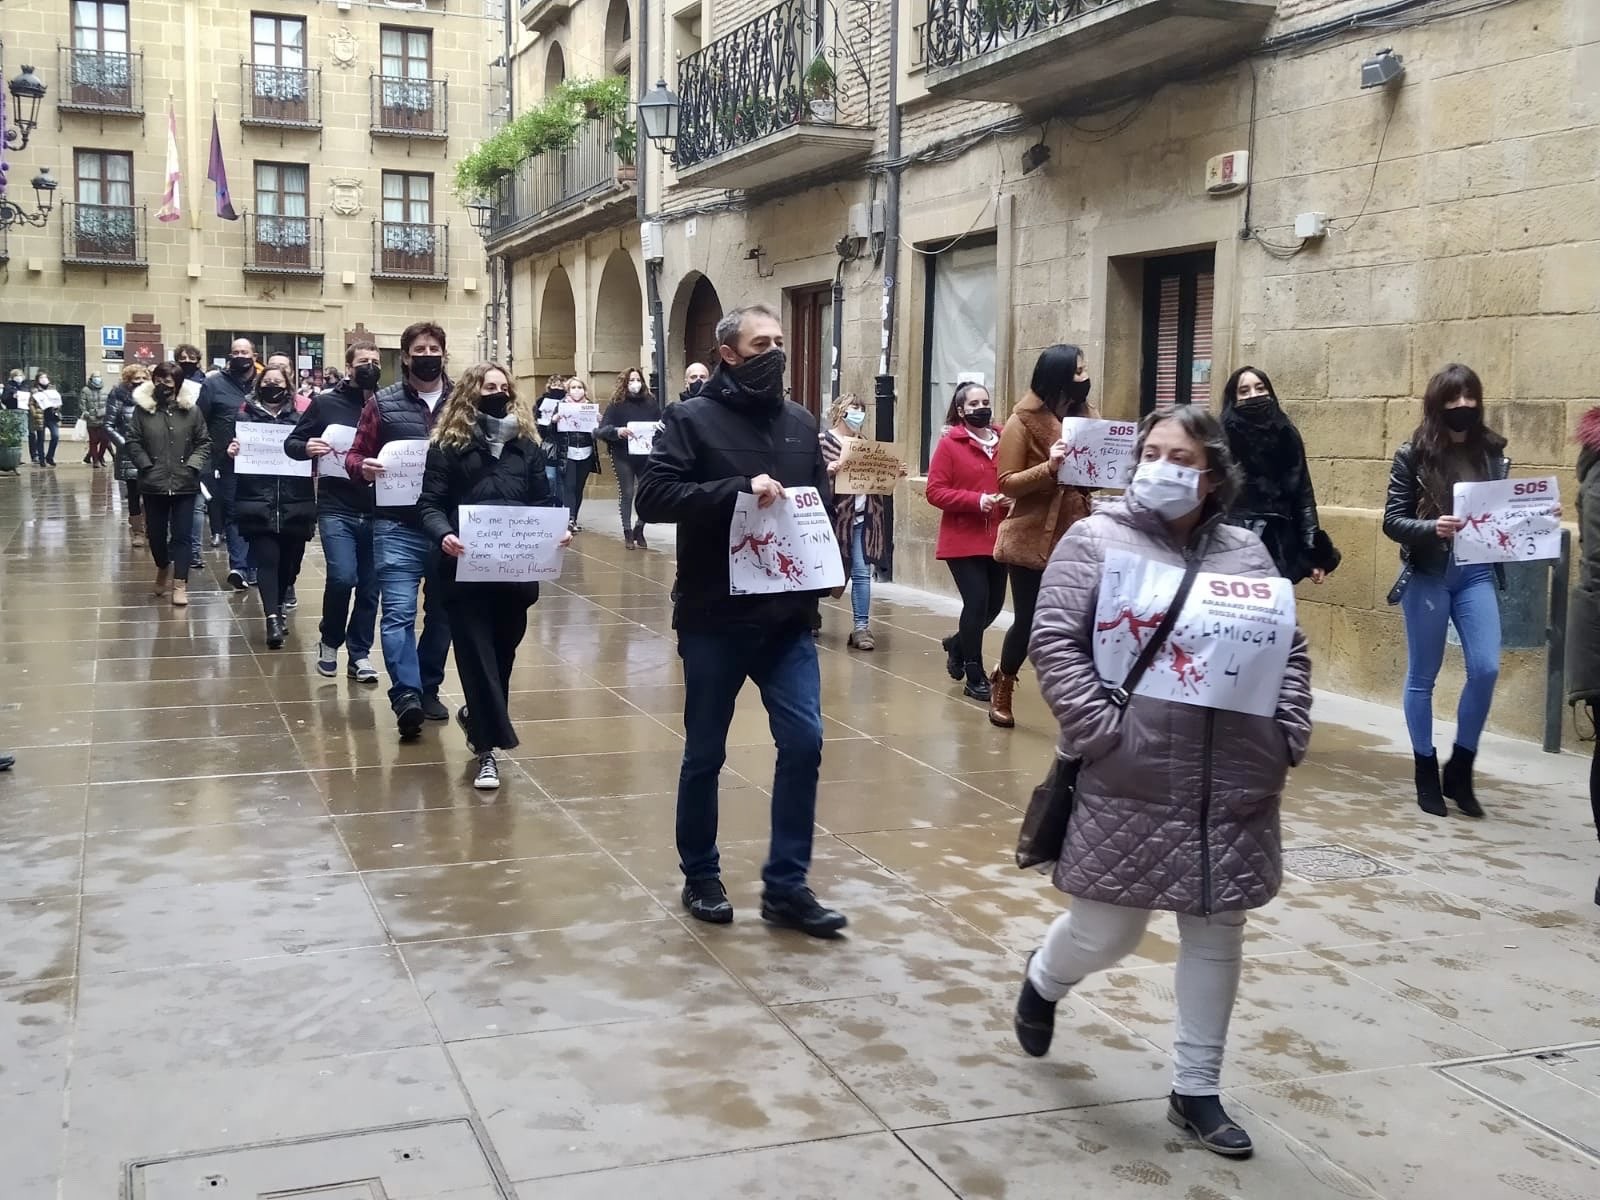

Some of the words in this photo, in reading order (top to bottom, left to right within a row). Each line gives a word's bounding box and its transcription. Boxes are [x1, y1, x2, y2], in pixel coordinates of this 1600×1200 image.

[107, 329, 118, 339] H
[1109, 426, 1134, 436] SOS
[1107, 460, 1118, 479] 5
[1514, 481, 1548, 495] SOS
[795, 492, 820, 509] SOS
[468, 511, 482, 524] No
[508, 516, 540, 528] puedes
[512, 529, 553, 540] impuestos
[1526, 536, 1537, 556] 3
[1209, 580, 1272, 600] SOS
[1224, 652, 1241, 688] 4
